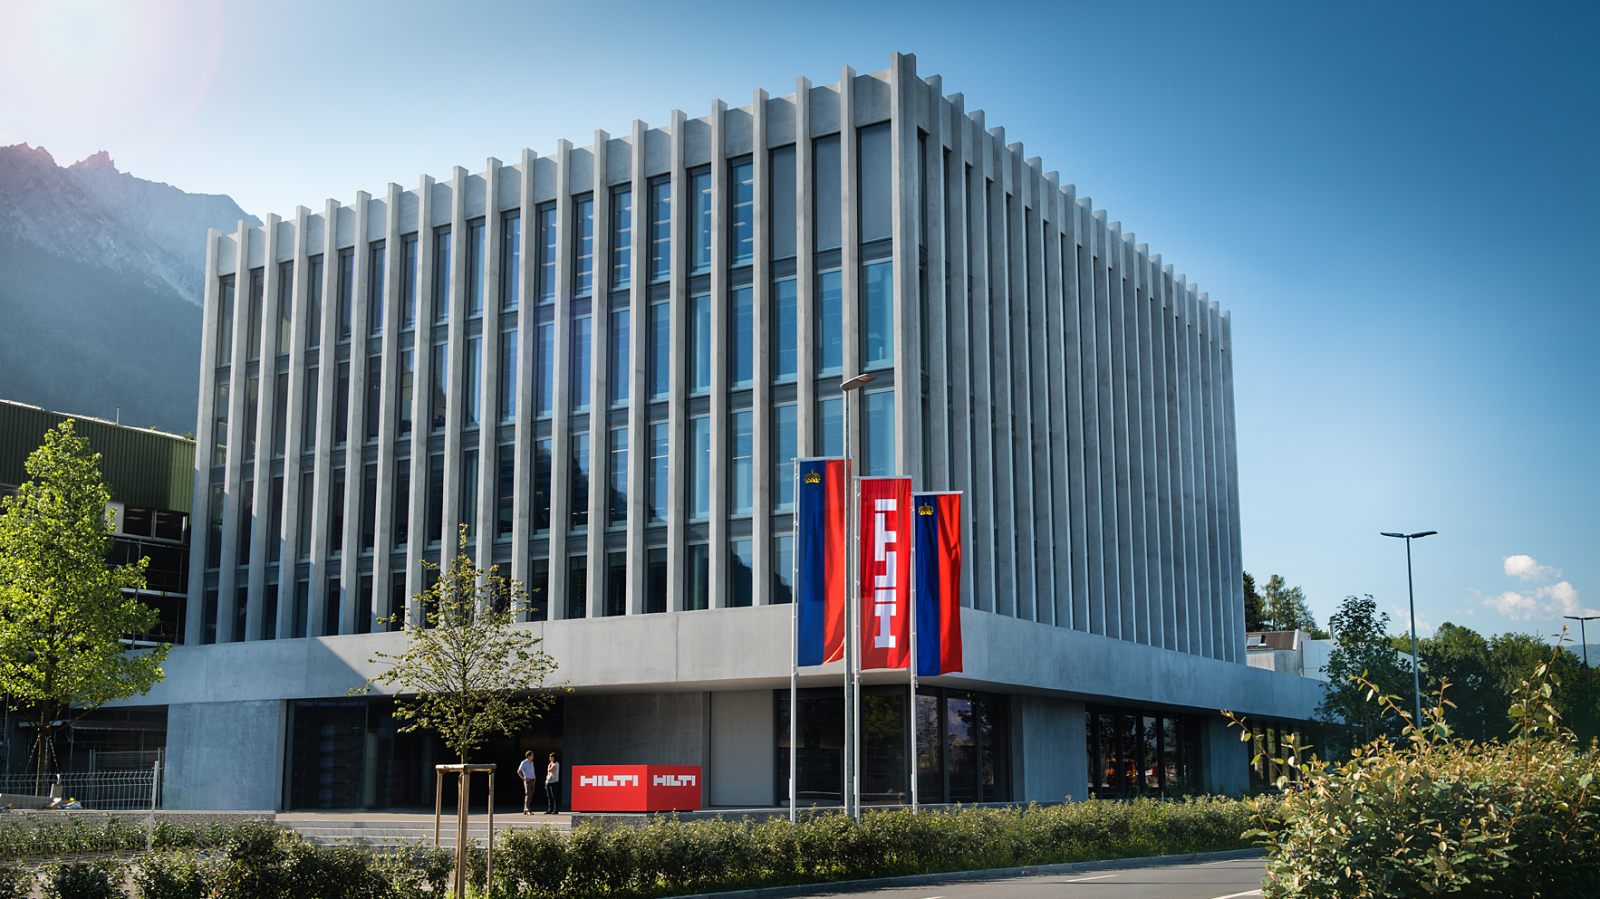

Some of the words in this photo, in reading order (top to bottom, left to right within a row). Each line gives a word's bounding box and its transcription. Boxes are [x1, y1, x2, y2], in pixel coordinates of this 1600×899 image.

[874, 498, 897, 648] HILTI
[580, 775, 638, 786] HILTI
[653, 775, 696, 786] HILTI
